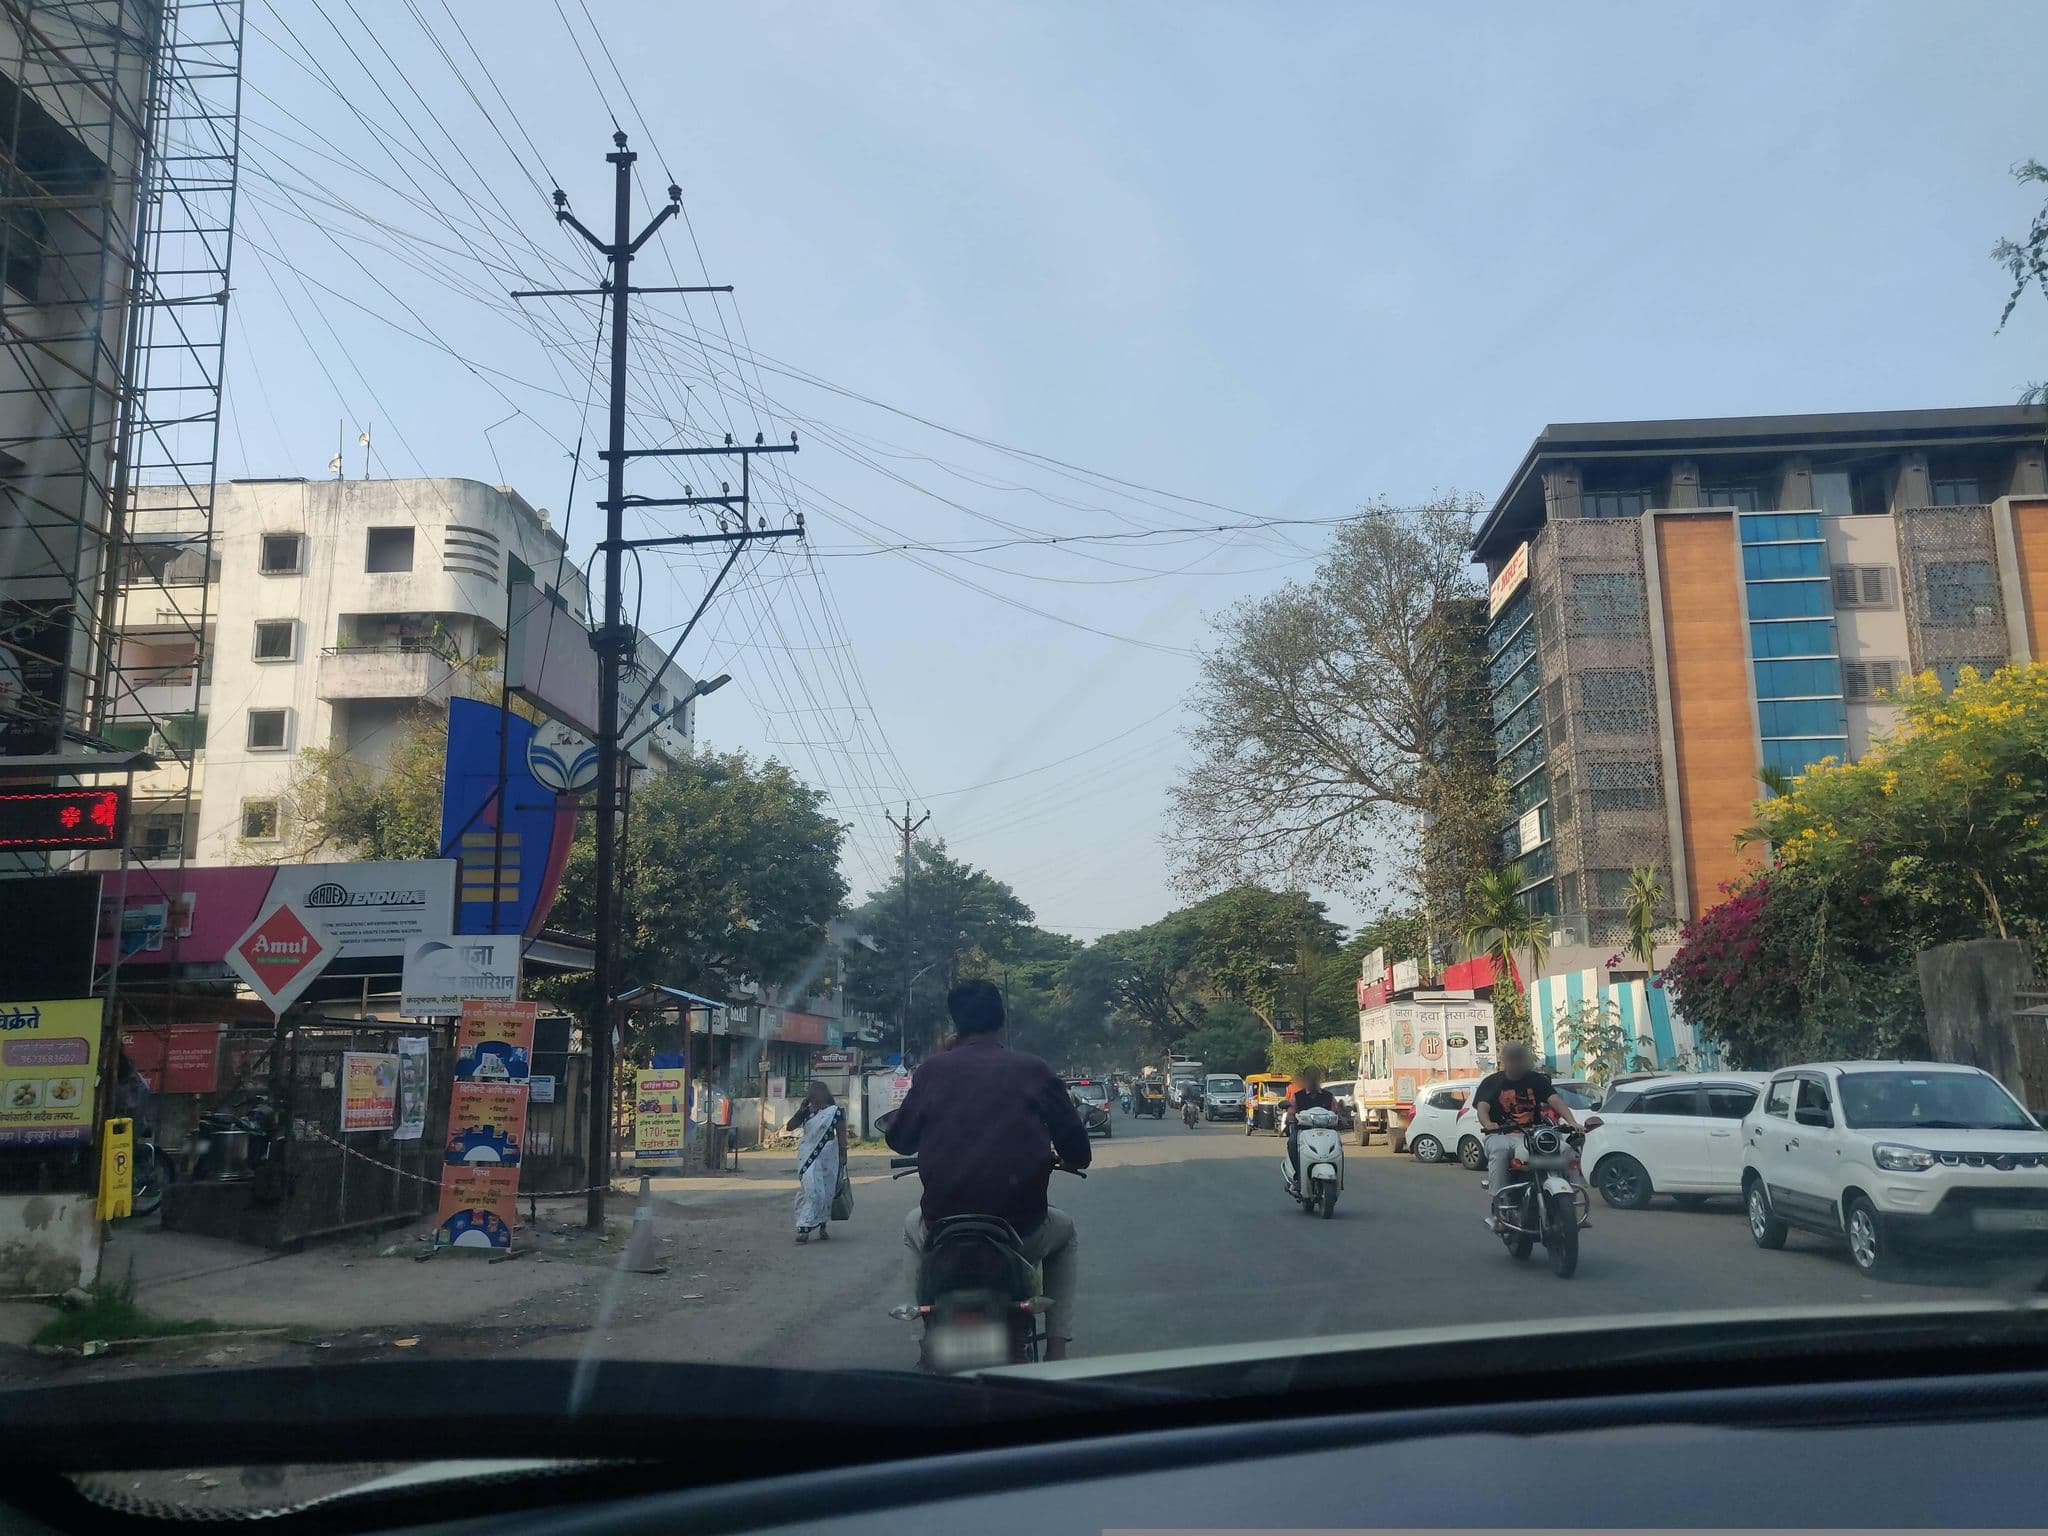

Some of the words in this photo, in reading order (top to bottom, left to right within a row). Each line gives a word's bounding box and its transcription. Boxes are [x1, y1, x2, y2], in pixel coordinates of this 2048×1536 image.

[312, 886, 345, 905] ARDEX
[354, 891, 417, 906] ENDURA
[252, 934, 308, 955] Amul
